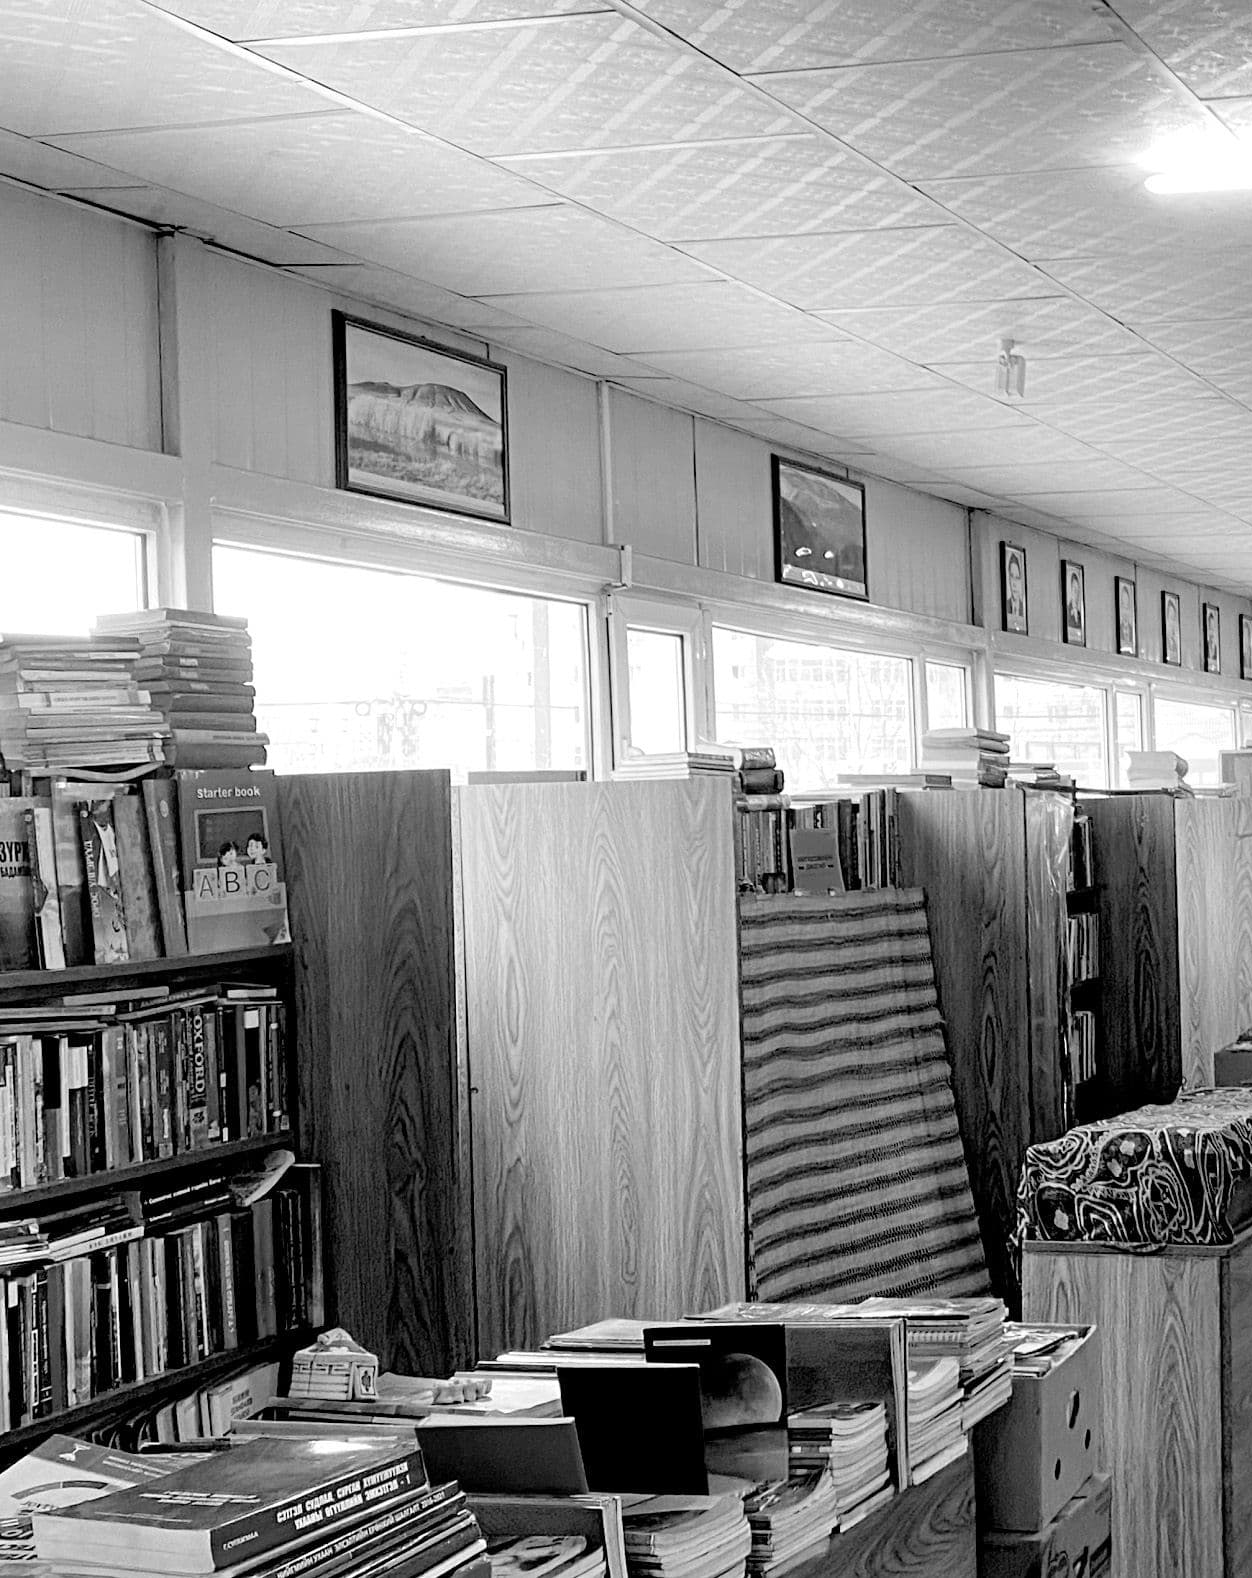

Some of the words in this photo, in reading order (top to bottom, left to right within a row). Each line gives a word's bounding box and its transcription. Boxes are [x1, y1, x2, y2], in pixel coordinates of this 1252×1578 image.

[197, 787, 232, 799] Starter
[235, 786, 261, 797] book
[193, 1015, 205, 1092] OXFORD
